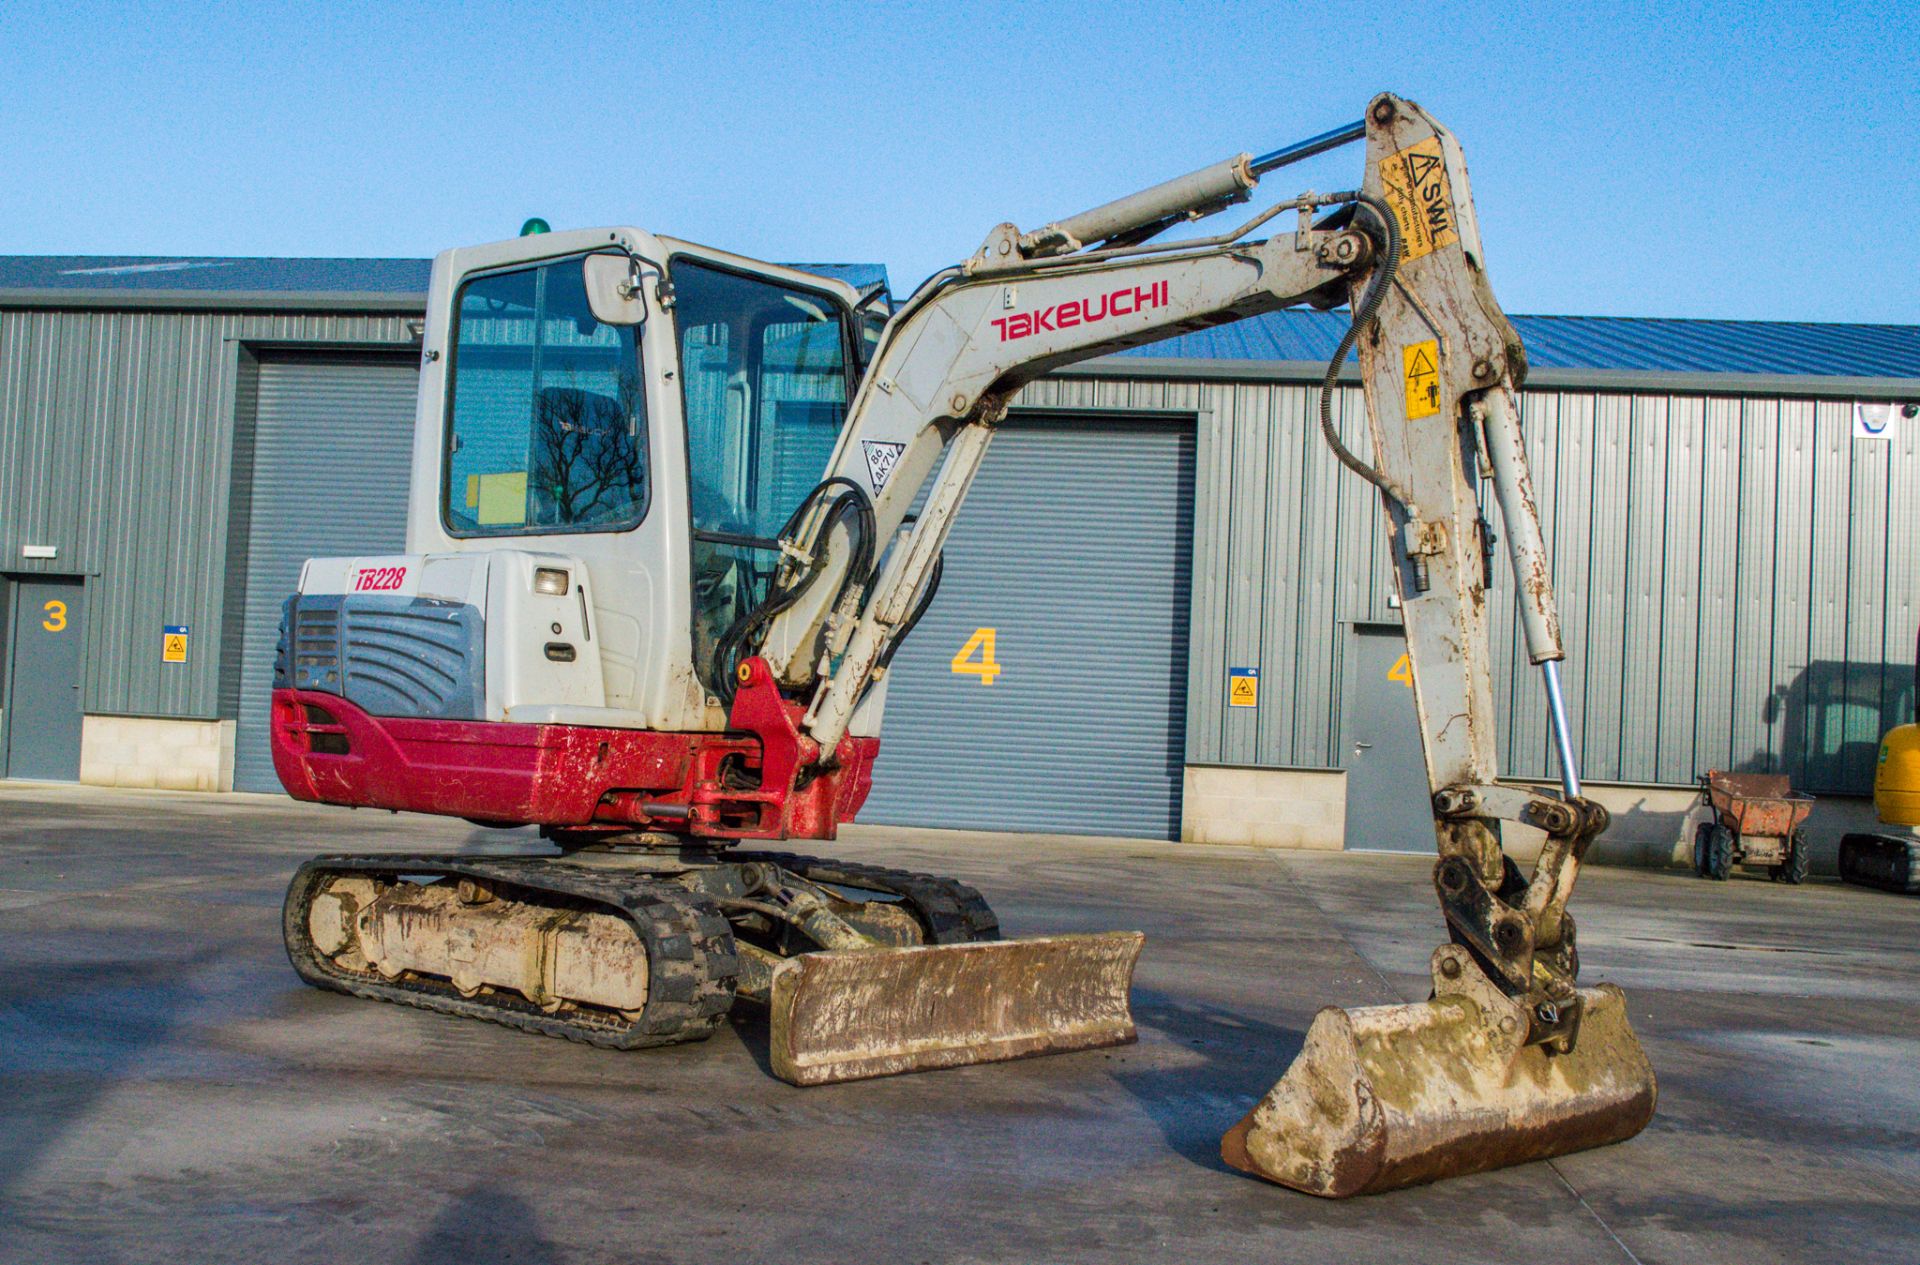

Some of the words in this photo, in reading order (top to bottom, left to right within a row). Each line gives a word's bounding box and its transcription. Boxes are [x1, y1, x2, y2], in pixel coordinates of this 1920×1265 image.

[1422, 183, 1448, 244] SWL
[871, 448, 883, 465] 86
[875, 447, 895, 482] AK7V
[355, 567, 407, 591] TB228
[43, 600, 67, 632] 3
[952, 628, 1001, 685] 4
[1387, 653, 1413, 688] 4
